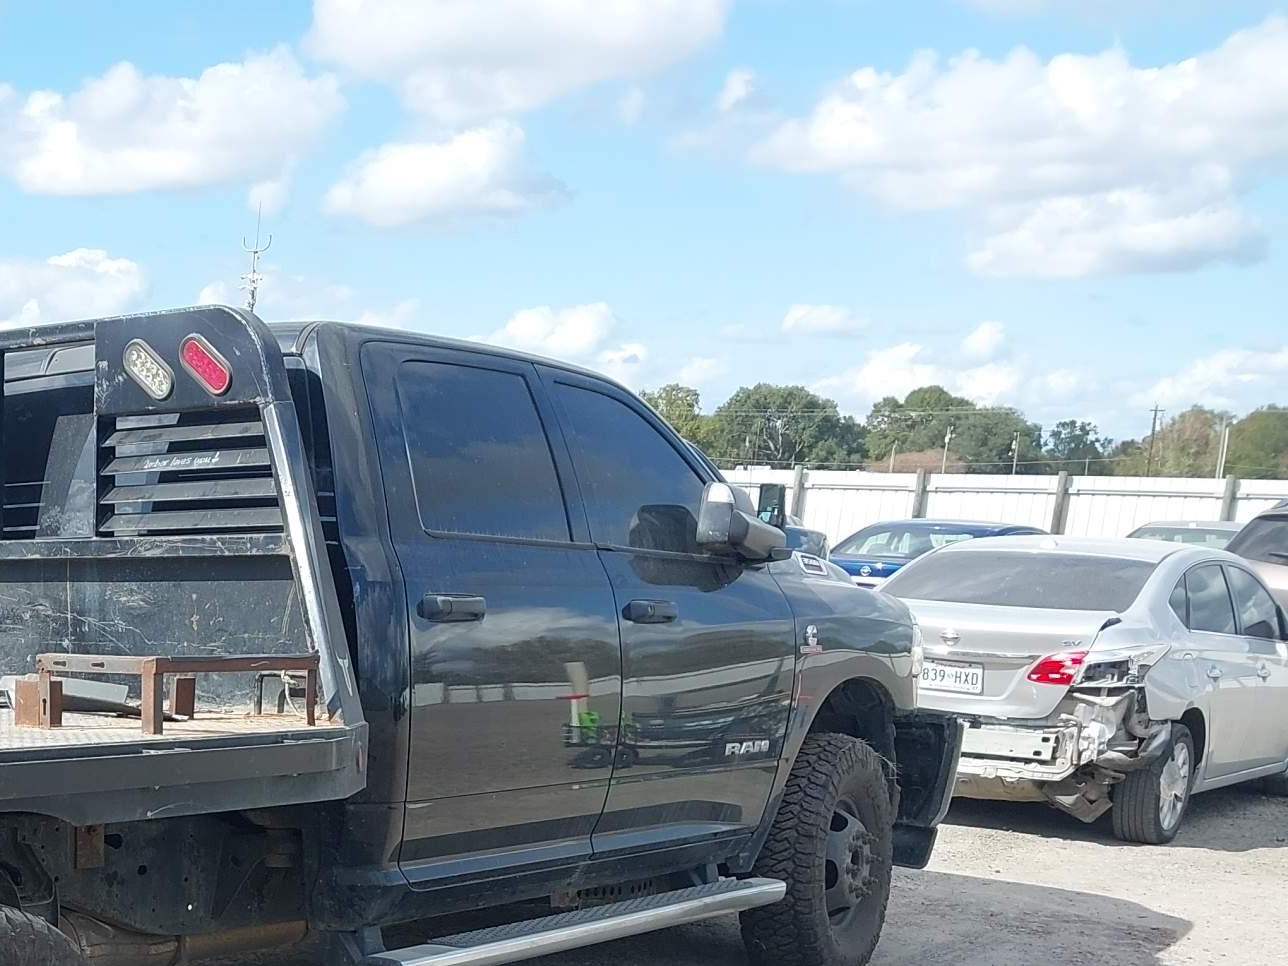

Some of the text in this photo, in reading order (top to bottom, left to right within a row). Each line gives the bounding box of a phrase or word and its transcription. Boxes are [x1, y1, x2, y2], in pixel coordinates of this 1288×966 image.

[922, 667, 979, 686] 839 HXD
[724, 739, 770, 756] RAM
